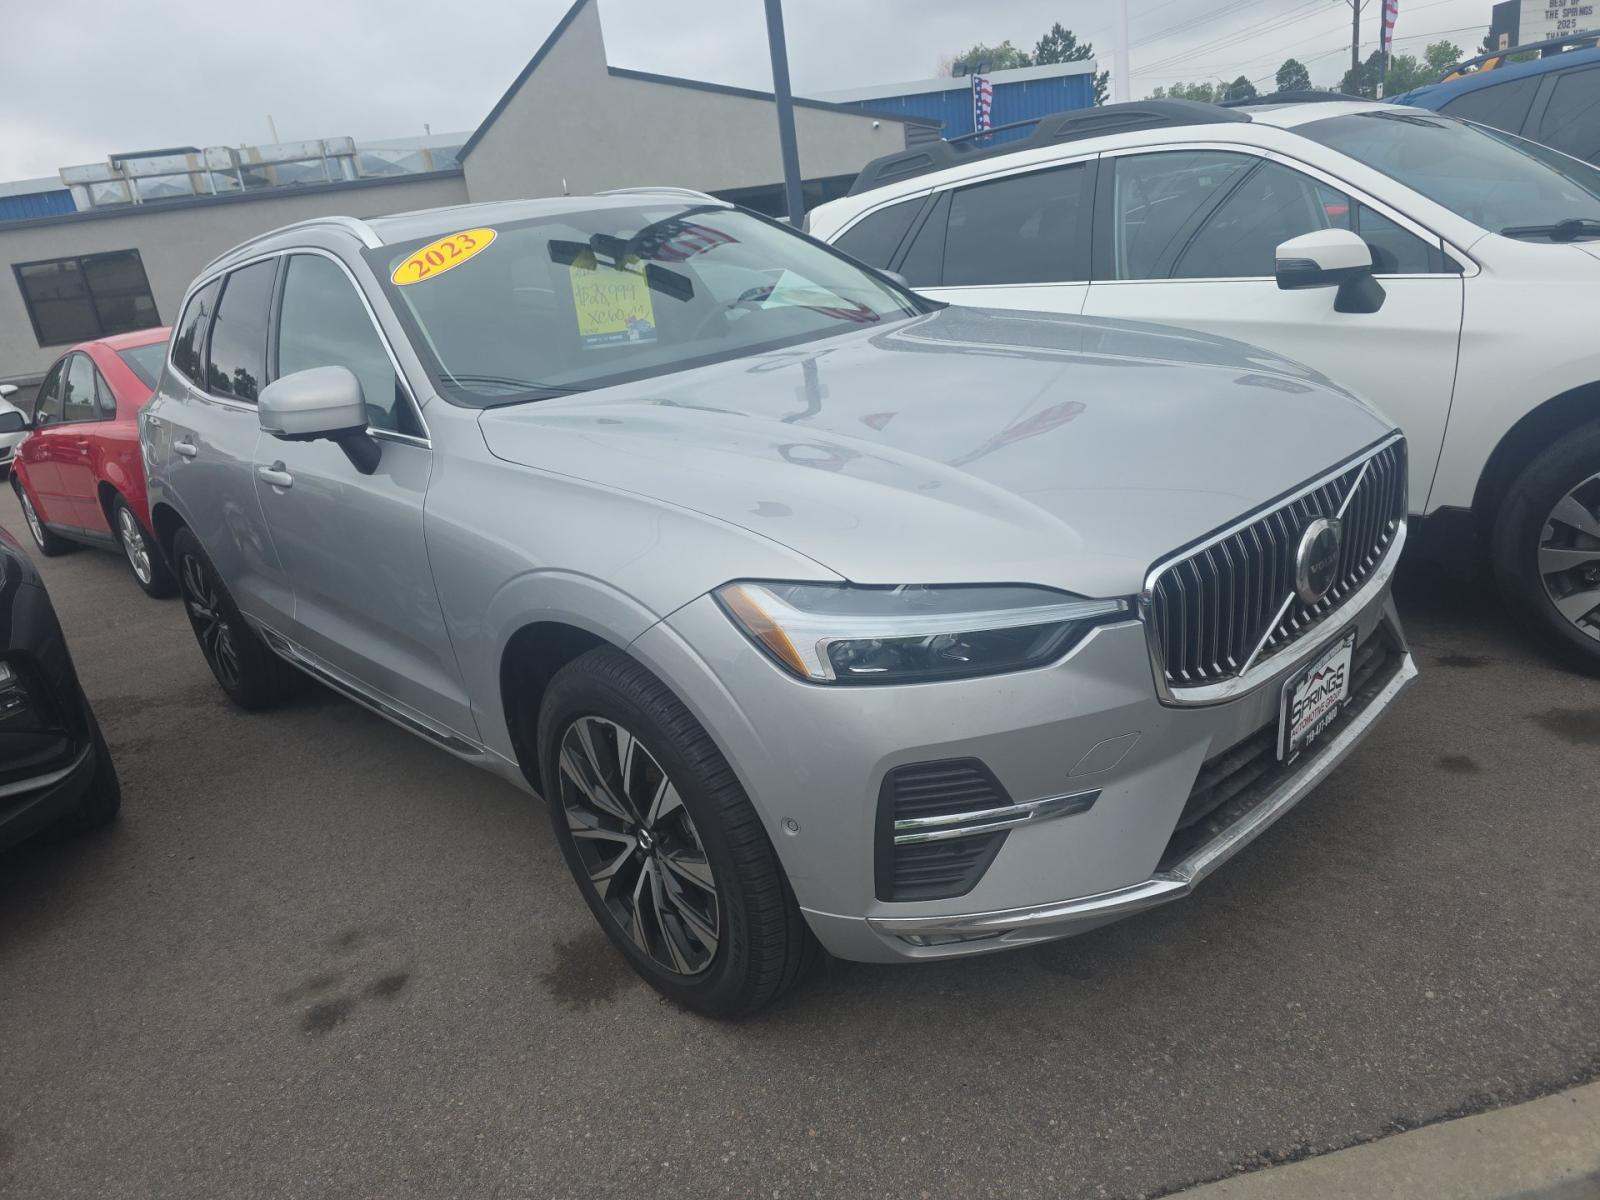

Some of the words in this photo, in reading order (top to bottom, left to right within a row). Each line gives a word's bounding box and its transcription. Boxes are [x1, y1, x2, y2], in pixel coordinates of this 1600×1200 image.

[1545, 9, 1559, 20] THE
[1562, 6, 1593, 18] SPRINGS
[1557, 19, 1577, 30] 2025
[408, 234, 476, 278] 2023
[1292, 663, 1344, 725] SPRINGS
